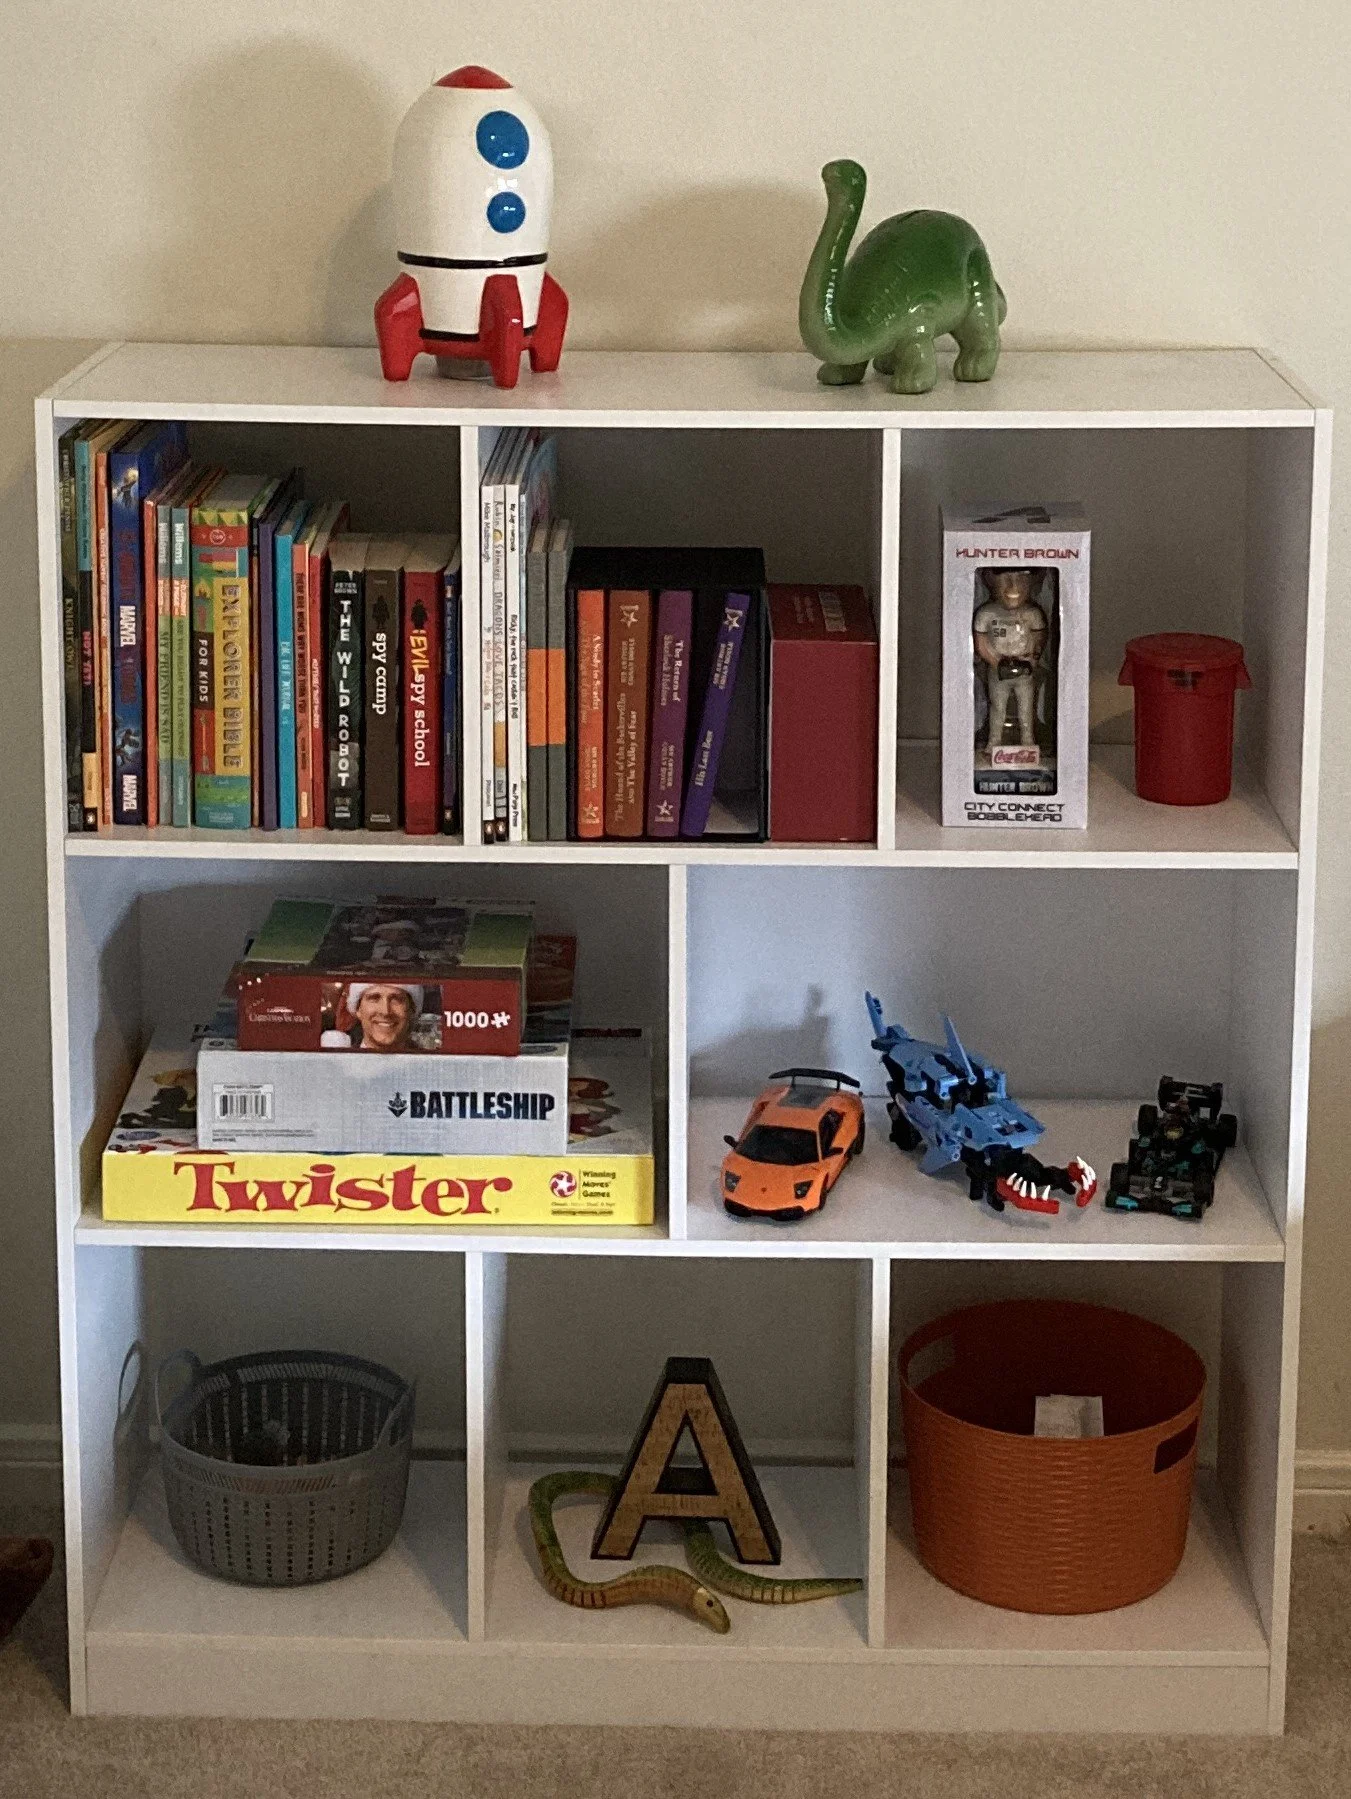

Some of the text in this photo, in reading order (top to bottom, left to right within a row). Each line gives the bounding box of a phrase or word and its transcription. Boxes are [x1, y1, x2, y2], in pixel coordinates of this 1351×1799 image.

[158, 522, 168, 564] Willems
[175, 522, 185, 565] Willems
[955, 549, 1079, 560] HUNTER BROWN
[119, 605, 137, 647] MARVEL
[340, 600, 351, 642] THE
[494, 591, 503, 636] DRAGONS
[298, 634, 306, 651] WAY
[494, 641, 503, 667] LOVE
[662, 634, 674, 671] Sherlock
[160, 631, 170, 744] MY FRIEND IS SAD
[199, 639, 209, 702] FOR KIDS
[222, 585, 243, 769] EXPLORER BIBLE
[337, 652, 353, 708] WILD
[372, 632, 389, 715] spy camp
[672, 640, 684, 702] The Return of
[410, 635, 430, 767] EVIL spy school
[592, 680, 602, 710] Scarlet
[338, 714, 351, 787] ROBOT
[627, 730, 637, 740] of
[701, 729, 714, 750] Bow
[627, 742, 638, 767] Valley
[698, 750, 710, 770] Last
[122, 774, 137, 812] MARVEL
[615, 772, 625, 803] Hound
[626, 769, 636, 787] The
[964, 802, 1066, 812] CITY CONNECT
[967, 812, 1063, 822] BOBBLEHEAD
[443, 1010, 488, 1028] 1000
[409, 1091, 555, 1121] BATTLESHIP
[173, 1161, 513, 1217] Twister
[582, 1171, 616, 1179] Winning
[582, 1190, 611, 1198] Games
[591, 1357, 782, 1566] A
